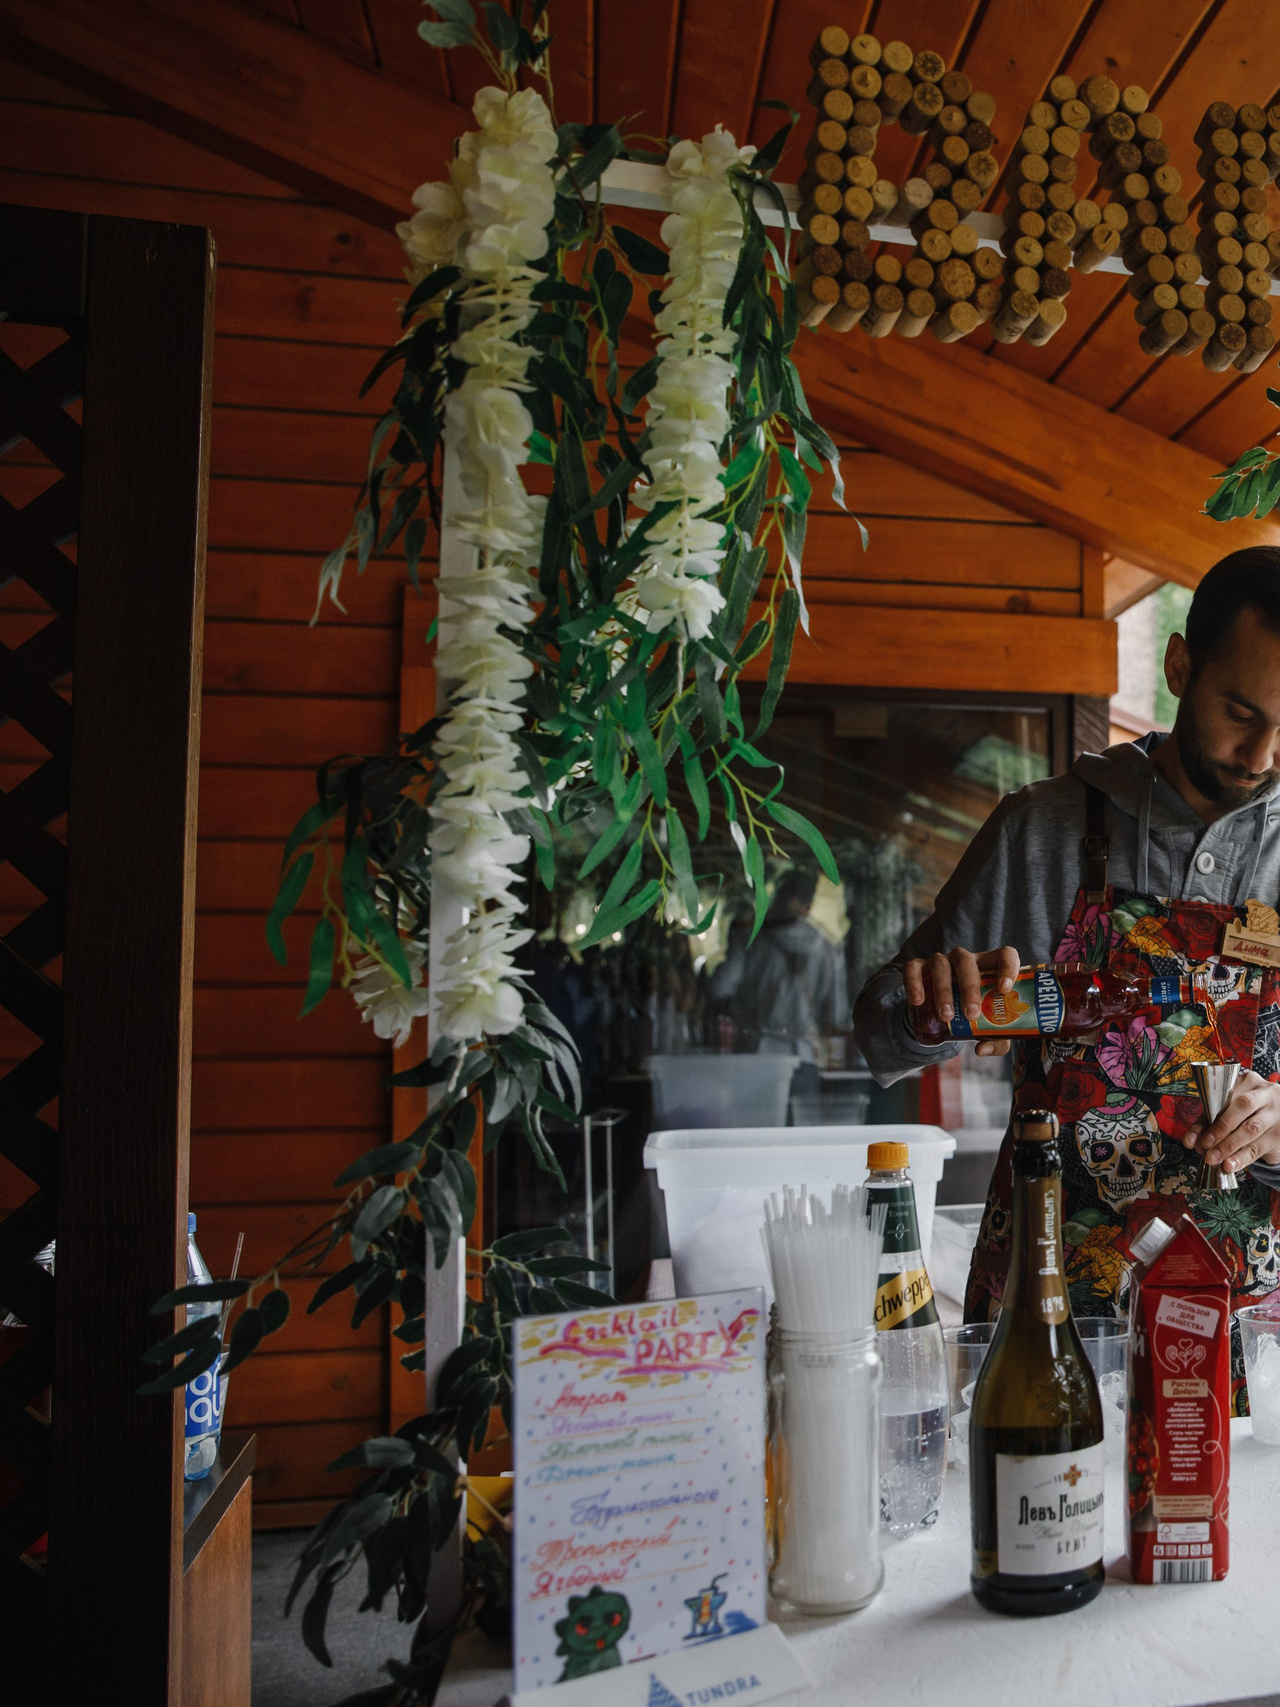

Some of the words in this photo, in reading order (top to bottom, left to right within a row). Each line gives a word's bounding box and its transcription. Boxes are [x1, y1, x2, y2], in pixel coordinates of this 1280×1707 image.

[1232, 940, 1270, 957] Дима
[1037, 972, 1060, 1033] APERITIVO
[874, 1271, 930, 1322] chweppe
[1170, 1300, 1176, 1308] С
[1176, 1303, 1211, 1318] ПОЛЬЗОЙ
[1179, 1311, 1196, 1321] ДЛЯ
[562, 1306, 679, 1344] Cocktail
[1165, 1315, 1205, 1332] ОБЩЕСТВА
[635, 1310, 756, 1365] PARTY
[1171, 1380, 1200, 1388] Растим
[1172, 1388, 1199, 1397] Добро
[1017, 1495, 1056, 1526] Левъ
[1056, 1536, 1087, 1554] БРЮТ
[685, 1674, 762, 1707] TUNDRA
